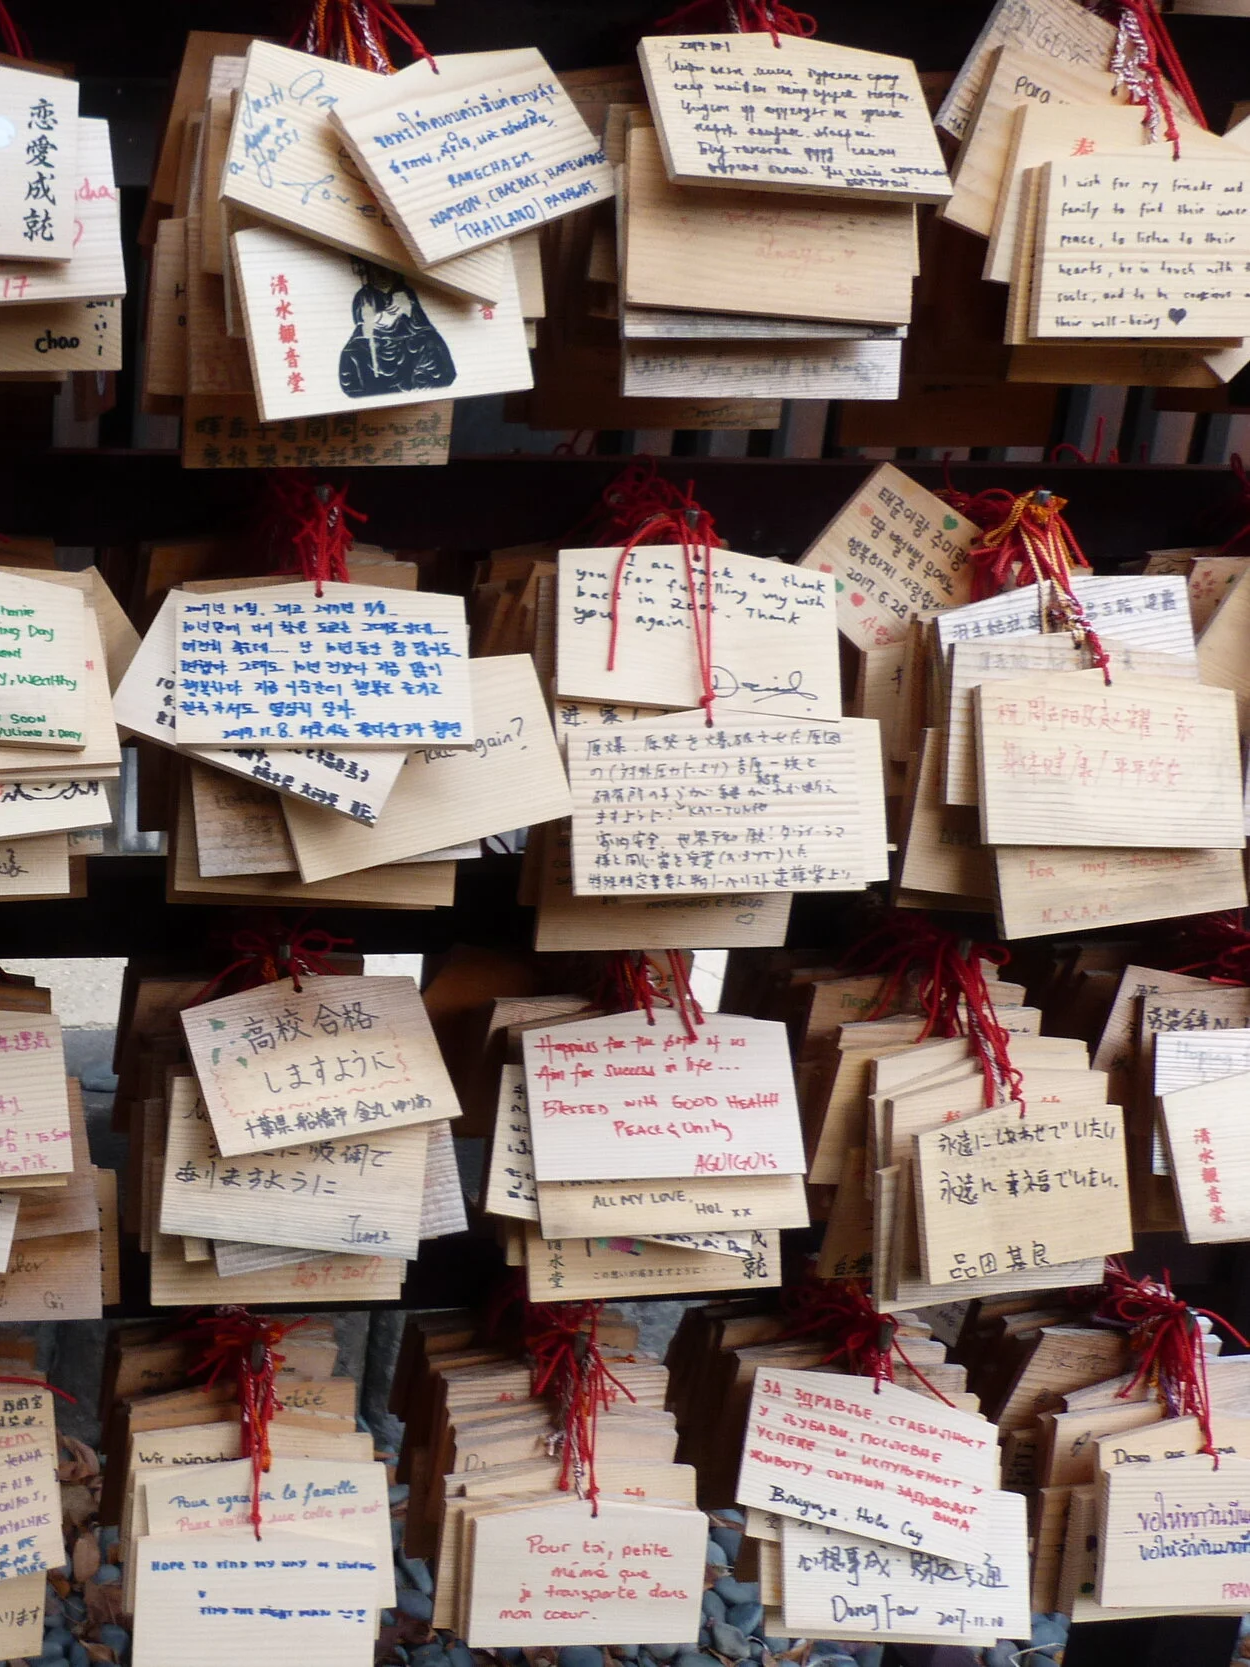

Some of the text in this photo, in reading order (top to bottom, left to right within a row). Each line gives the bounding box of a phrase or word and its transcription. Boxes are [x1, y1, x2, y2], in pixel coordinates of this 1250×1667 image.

[22, 98, 59, 242] 恋愛成就
[1077, 175, 1243, 194] wish for my friends and
[1061, 201, 1205, 219] family find their
[1204, 232, 1236, 245] their
[1160, 259, 1195, 276] touch
[576, 568, 826, 608] you for my wish
[781, 575, 826, 593] thank
[635, 615, 691, 631] again.
[746, 608, 801, 624] Thank
[28, 625, 55, 642] Day
[264, 1049, 395, 1095] しますように
[672, 1095, 717, 1110] GOOD
[593, 1195, 617, 1208] ALL
[621, 1194, 644, 1206] MY
[527, 1535, 571, 1554] Pour
[622, 1543, 673, 1558] petite
[193, 1560, 208, 1568] TO
[254, 1560, 275, 1568] MY
[619, 1569, 652, 1584] que
[519, 1583, 688, 1603] je transporte dans
[499, 1609, 532, 1619] mon
